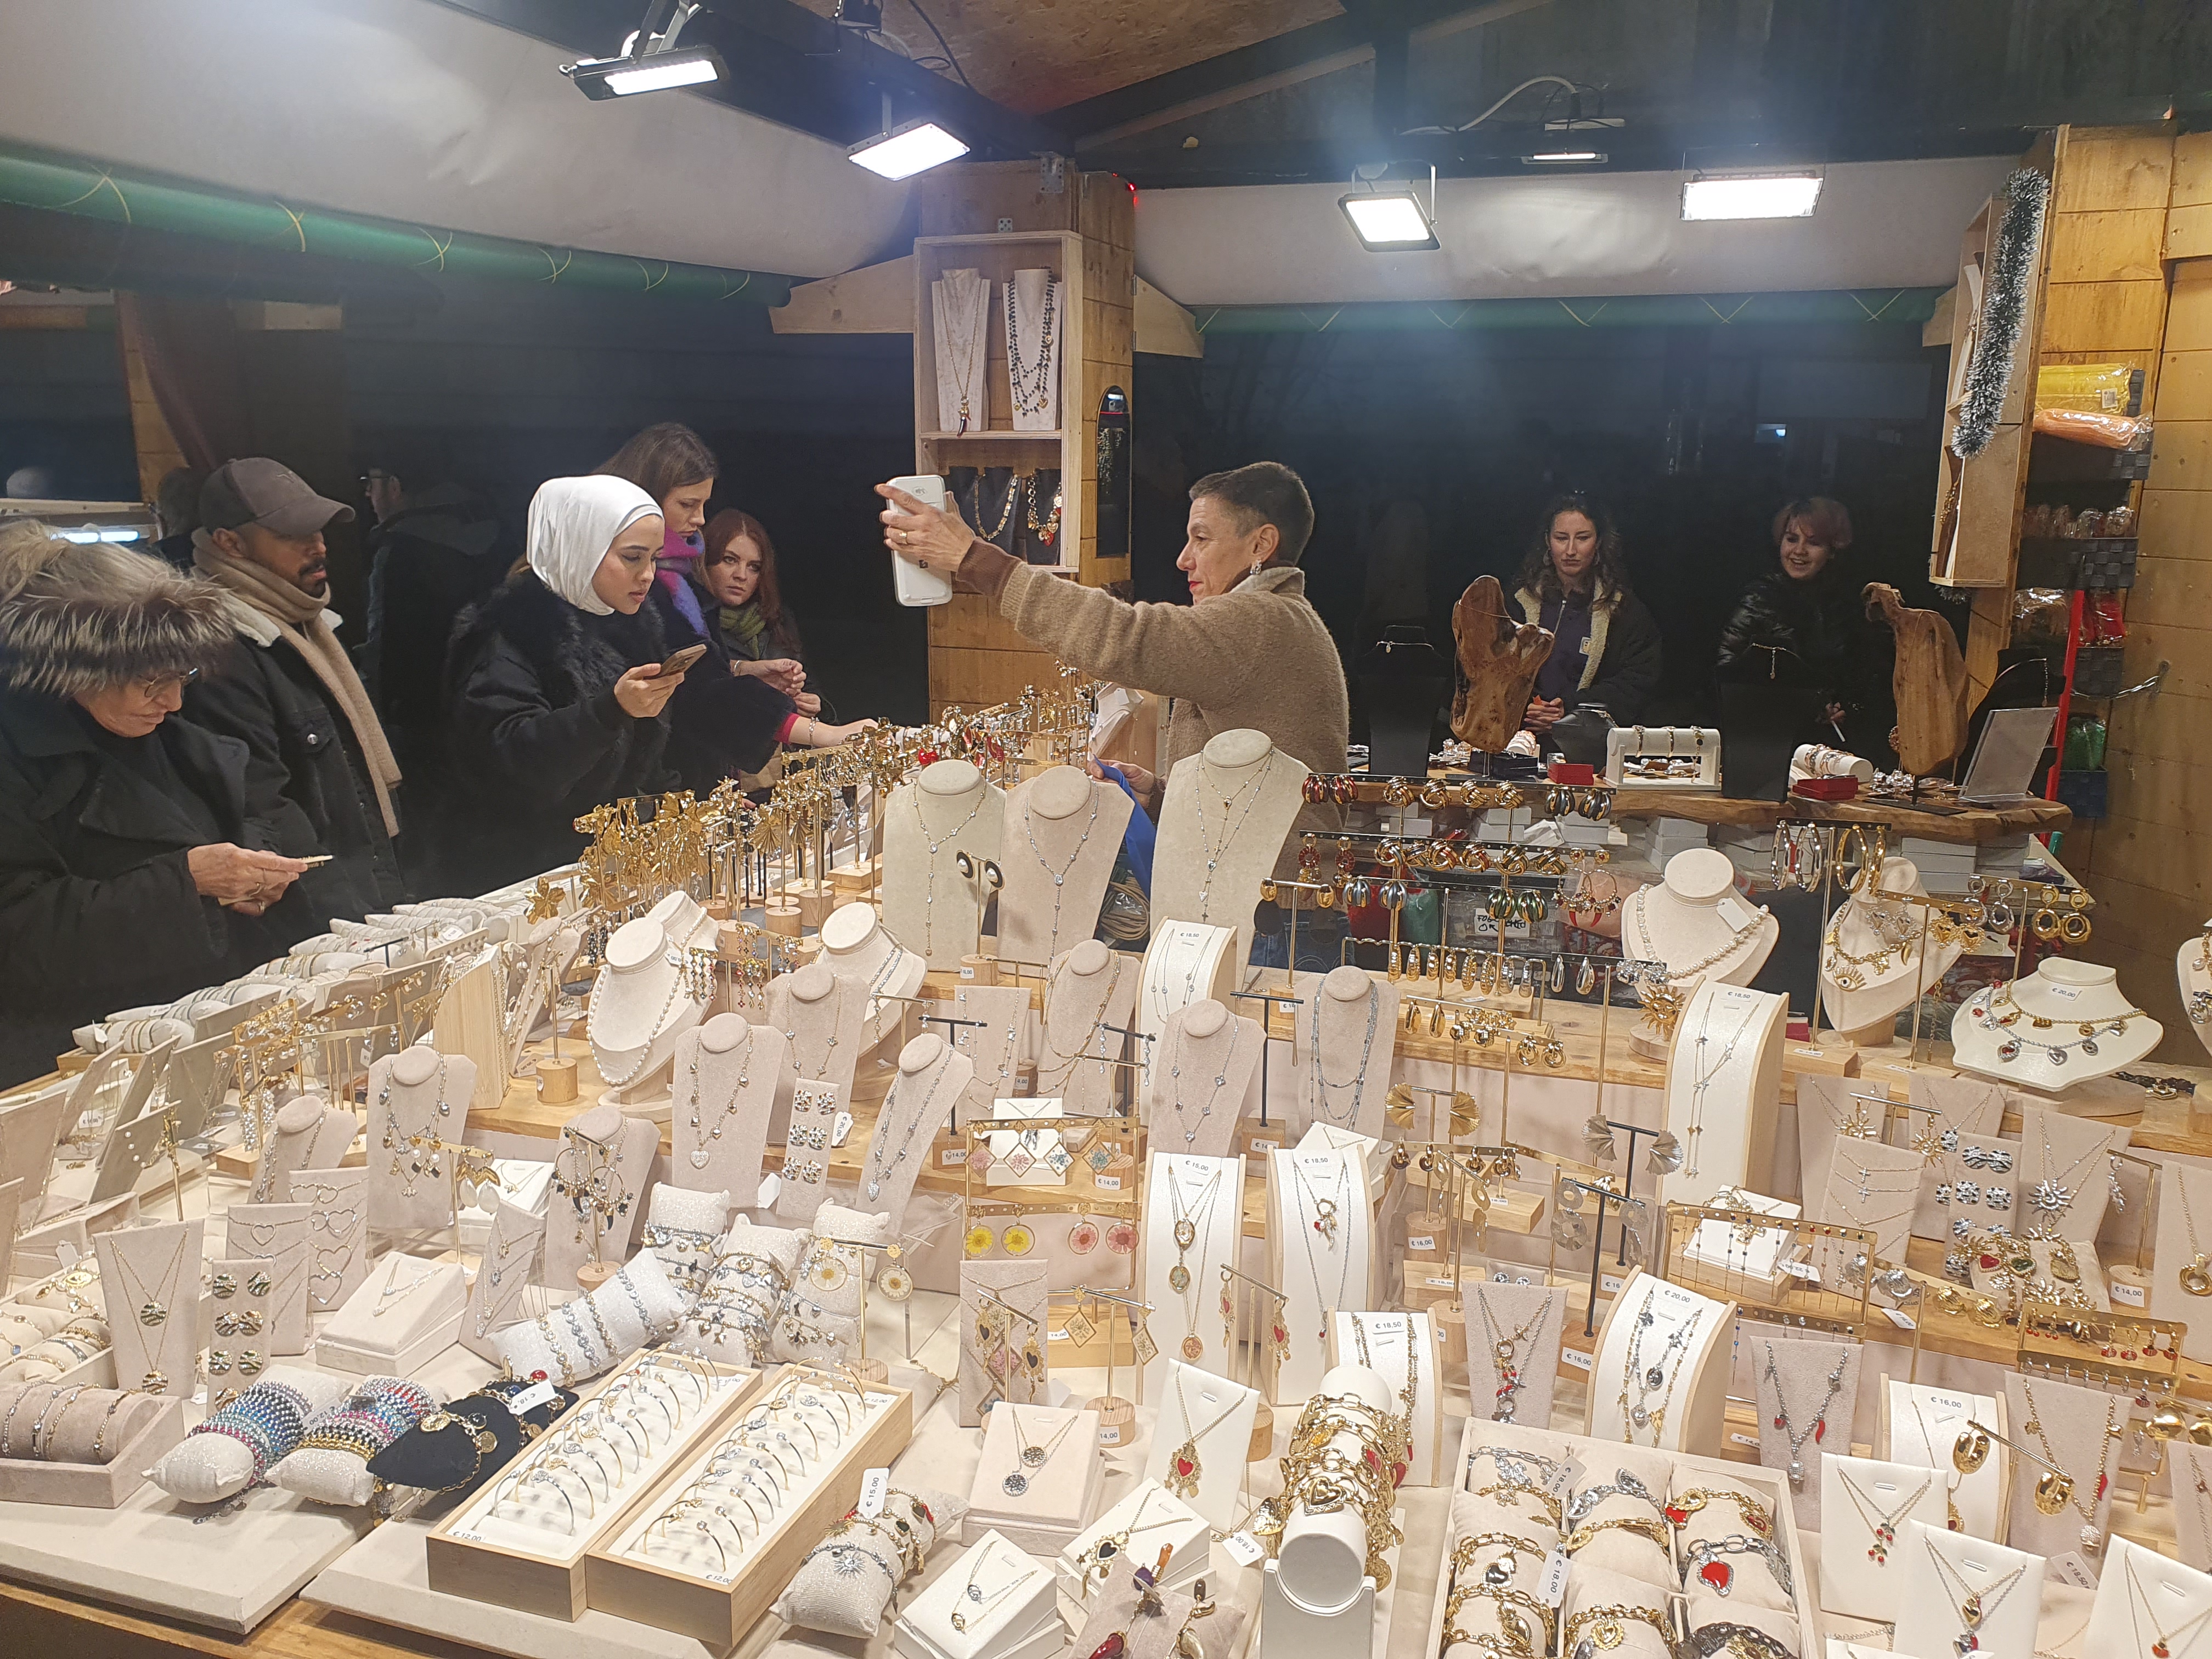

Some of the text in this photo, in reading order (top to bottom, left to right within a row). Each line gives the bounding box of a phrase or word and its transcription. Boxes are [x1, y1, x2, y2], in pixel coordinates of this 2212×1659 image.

[2058, 989, 2076, 998] 20,00
[1192, 1162, 1209, 1171] 15,00
[1671, 1291, 1691, 1303] 20,00
[2121, 1288, 2142, 1297] 14,00
[1573, 1355, 1592, 1366] 16,00
[1940, 1399, 1962, 1408] 16,00
[868, 1477, 879, 1498] 15,00
[1553, 1474, 1566, 1493] 18,00
[461, 1533, 482, 1542] 12,00
[1235, 1536, 1250, 1549] 18,00
[1550, 1569, 1560, 1593] 18,00
[2072, 1566, 2089, 1586] 18,50
